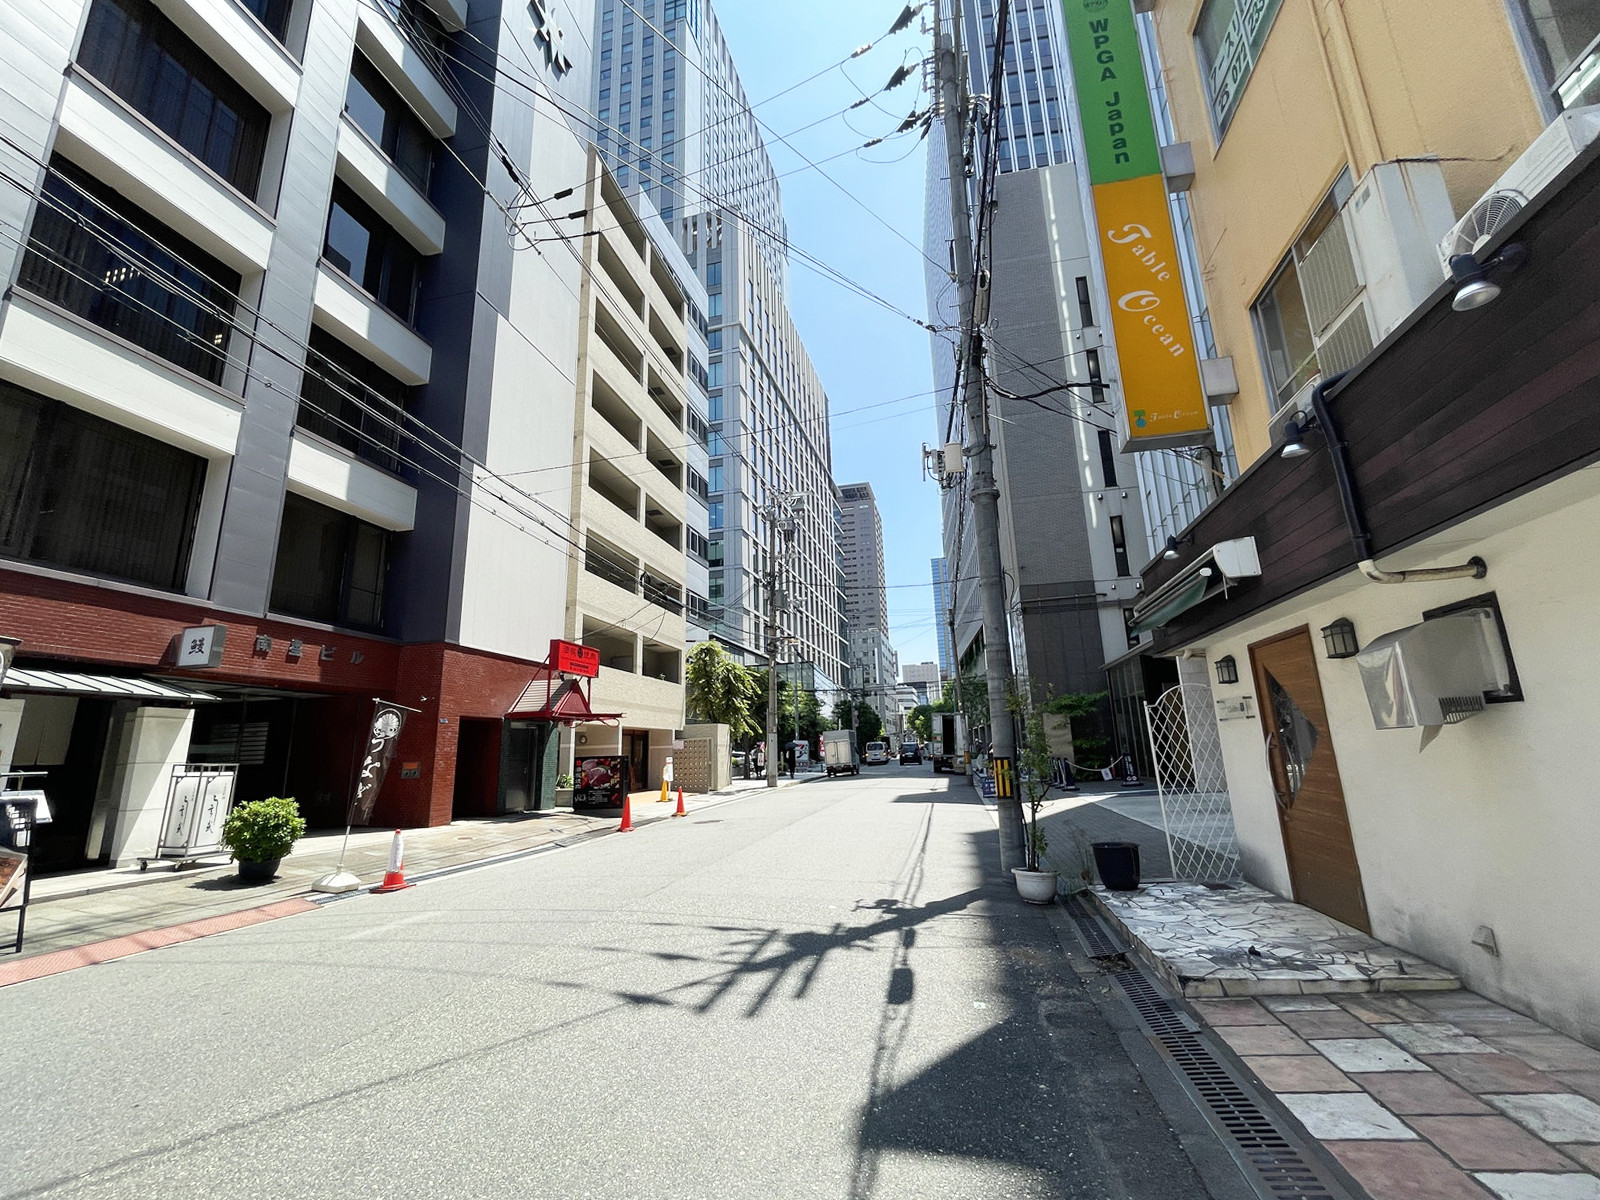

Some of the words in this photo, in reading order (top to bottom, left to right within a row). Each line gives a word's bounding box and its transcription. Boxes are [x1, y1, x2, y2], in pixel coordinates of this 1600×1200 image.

[1089, 18, 1117, 82] WPGA
[1105, 91, 1130, 164] Japan
[1107, 223, 1170, 282] Table
[1117, 289, 1185, 357] Ocean
[188, 637, 205, 655] 鰻
[256, 634, 365, 665] 南星ビル
